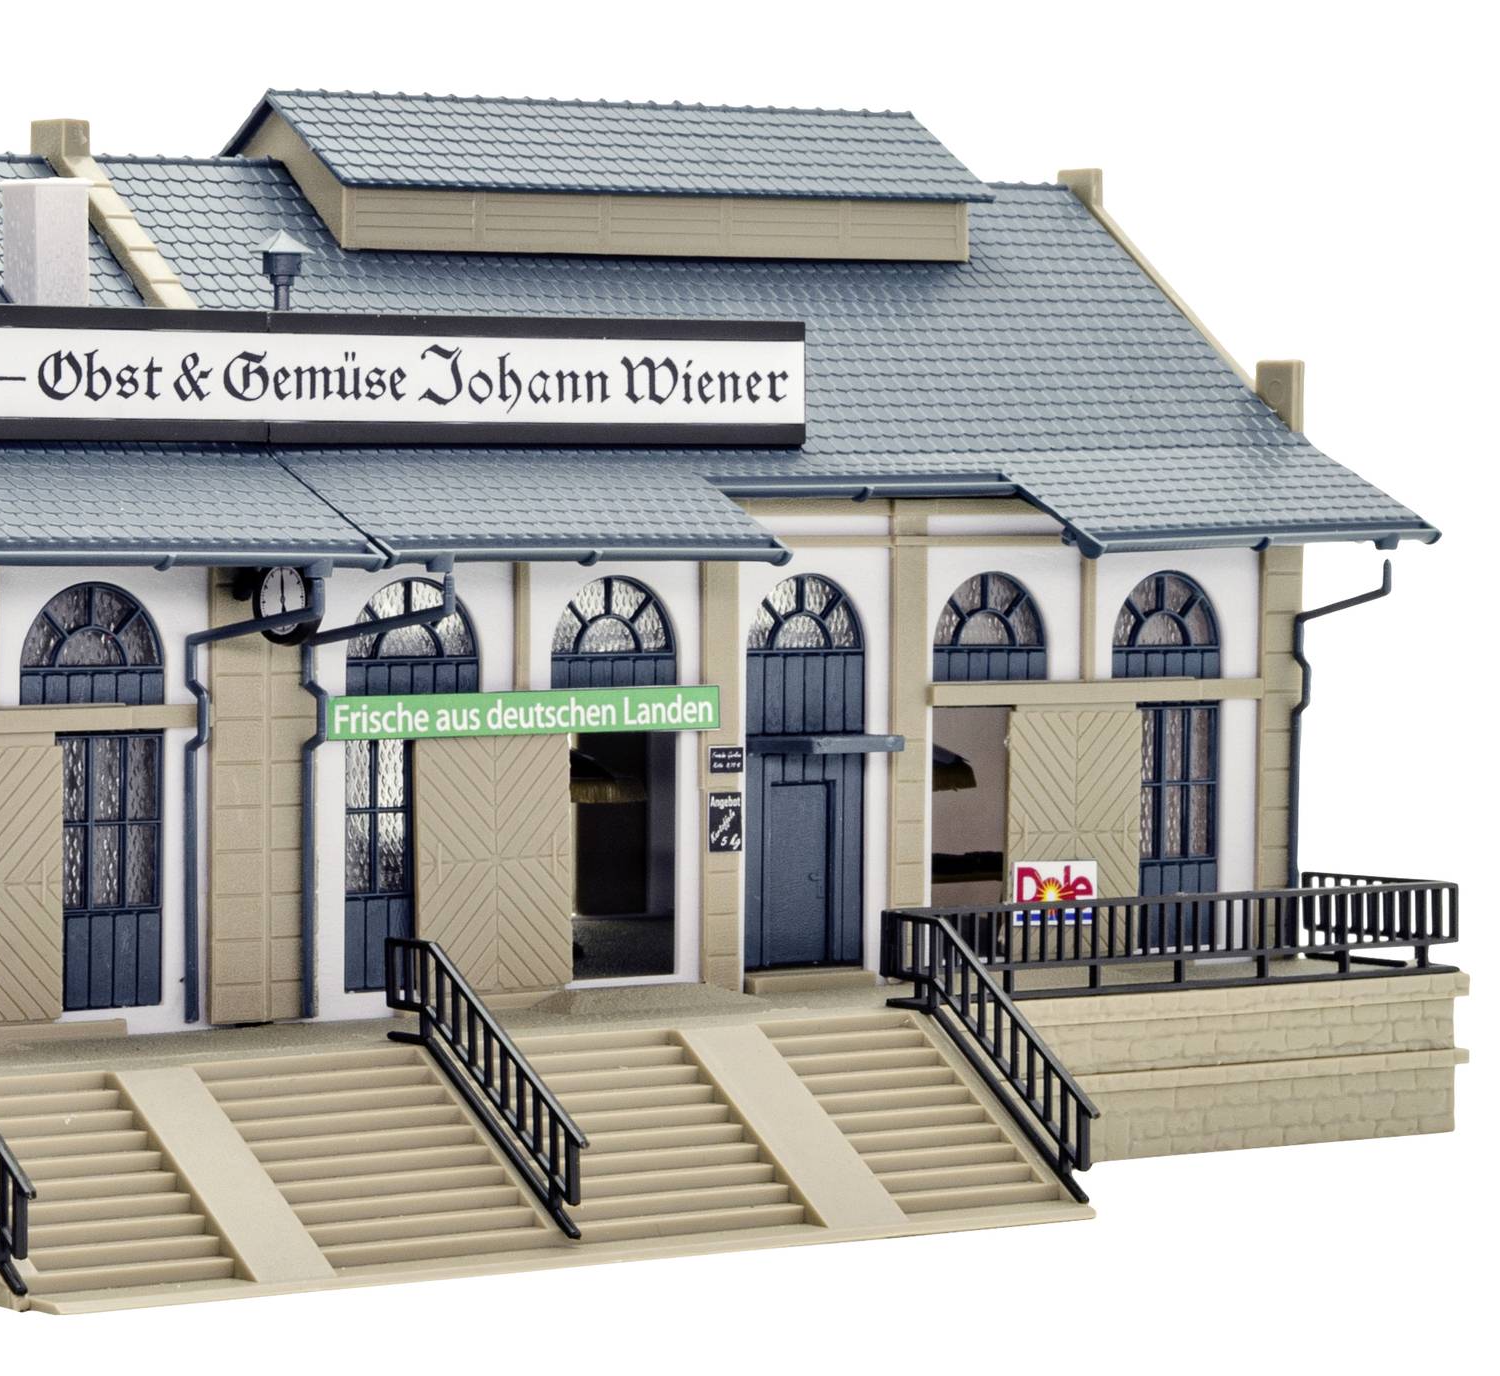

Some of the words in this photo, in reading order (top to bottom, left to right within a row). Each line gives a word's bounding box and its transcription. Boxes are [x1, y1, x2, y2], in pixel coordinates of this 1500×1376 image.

[37, 349, 163, 402] Obst
[173, 352, 214, 403] &
[223, 350, 408, 403] Gemüse
[418, 344, 610, 410] Johann
[620, 356, 790, 406] Wiener
[334, 699, 430, 735] Frische
[435, 707, 481, 732] aus
[486, 695, 617, 731] deutschen
[623, 690, 714, 727] Landen
[710, 795, 740, 809] Angebot
[720, 836, 728, 846] 5
[1016, 864, 1094, 905] Dole
